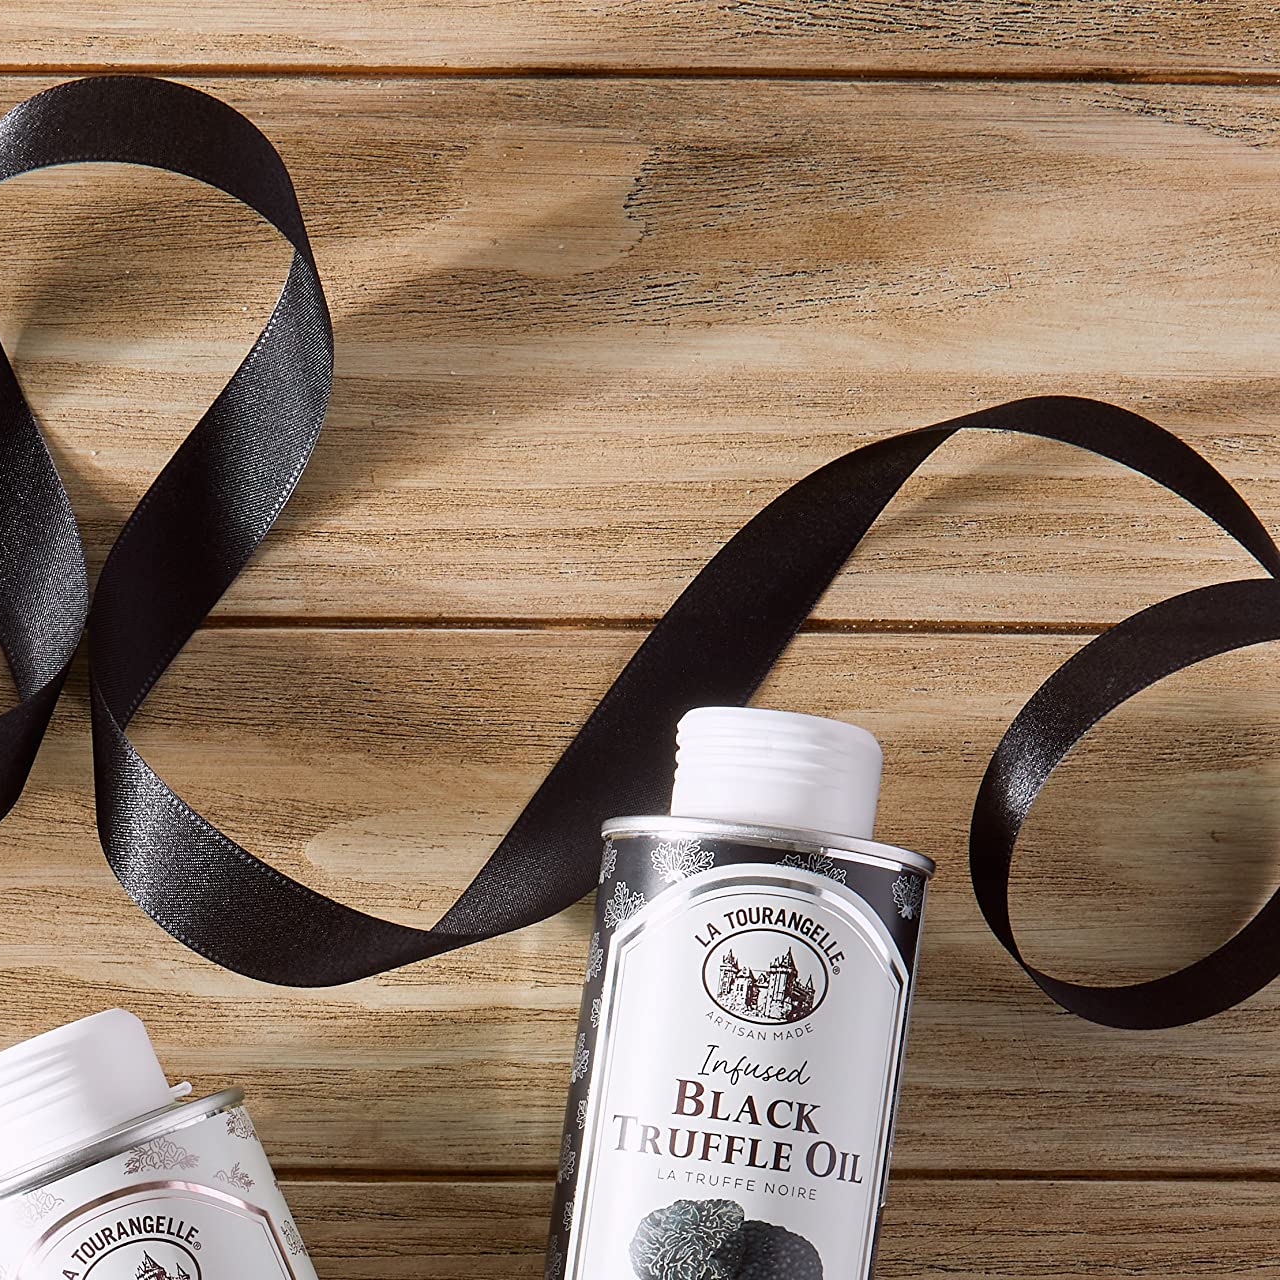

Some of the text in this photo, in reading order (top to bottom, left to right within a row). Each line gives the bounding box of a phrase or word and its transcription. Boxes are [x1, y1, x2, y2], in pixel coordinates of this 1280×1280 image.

[695, 923, 722, 947] LA
[705, 1011, 814, 1041] ARTISAN MADE
[697, 1044, 811, 1086] Infused
[672, 1078, 821, 1135] BLACK
[613, 1114, 794, 1173] TRUFFLE
[657, 1167, 817, 1201] LA TRUFFE NOIRE
